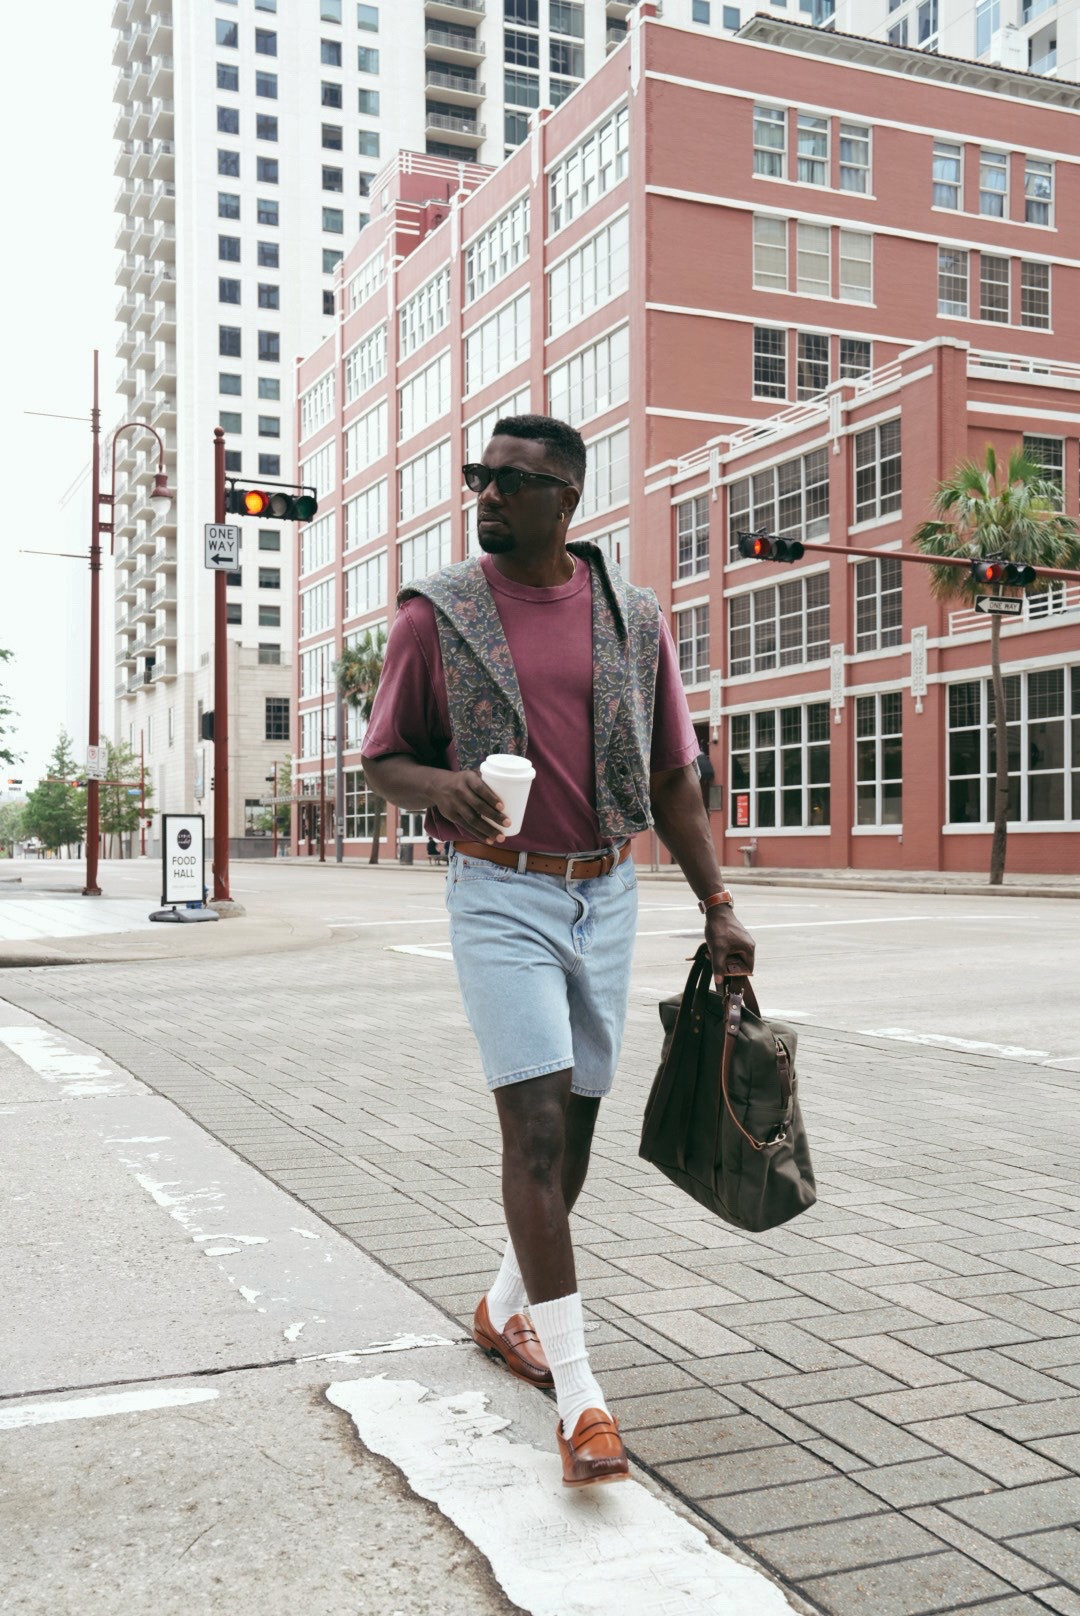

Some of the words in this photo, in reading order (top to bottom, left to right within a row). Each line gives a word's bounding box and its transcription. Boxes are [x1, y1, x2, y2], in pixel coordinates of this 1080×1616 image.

[209, 527, 234, 539] ONE
[208, 540, 235, 551] WAY
[990, 601, 1002, 609] ONE
[172, 856, 196, 865] FOOD
[173, 869, 195, 878] HALL
